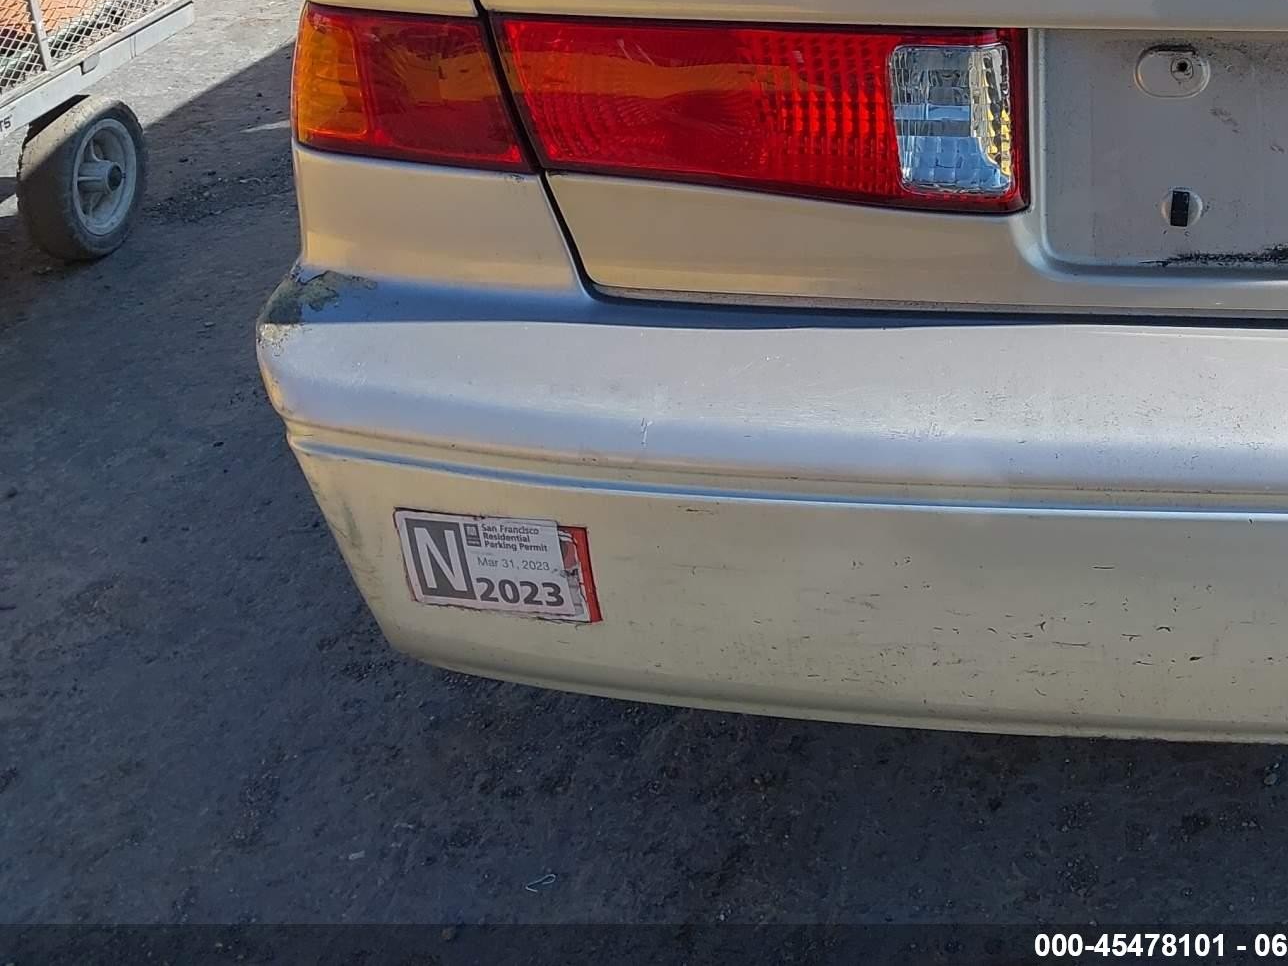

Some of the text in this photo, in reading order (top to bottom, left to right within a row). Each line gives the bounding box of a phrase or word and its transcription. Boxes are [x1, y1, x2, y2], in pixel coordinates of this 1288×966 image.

[482, 523, 540, 535] San Francisco
[482, 532, 531, 543] Residential
[484, 540, 518, 552] Parking
[519, 542, 548, 552] Permit
[413, 526, 469, 593] N
[477, 556, 499, 567] Mar
[521, 559, 550, 571] 2023
[476, 577, 565, 607] 2023
